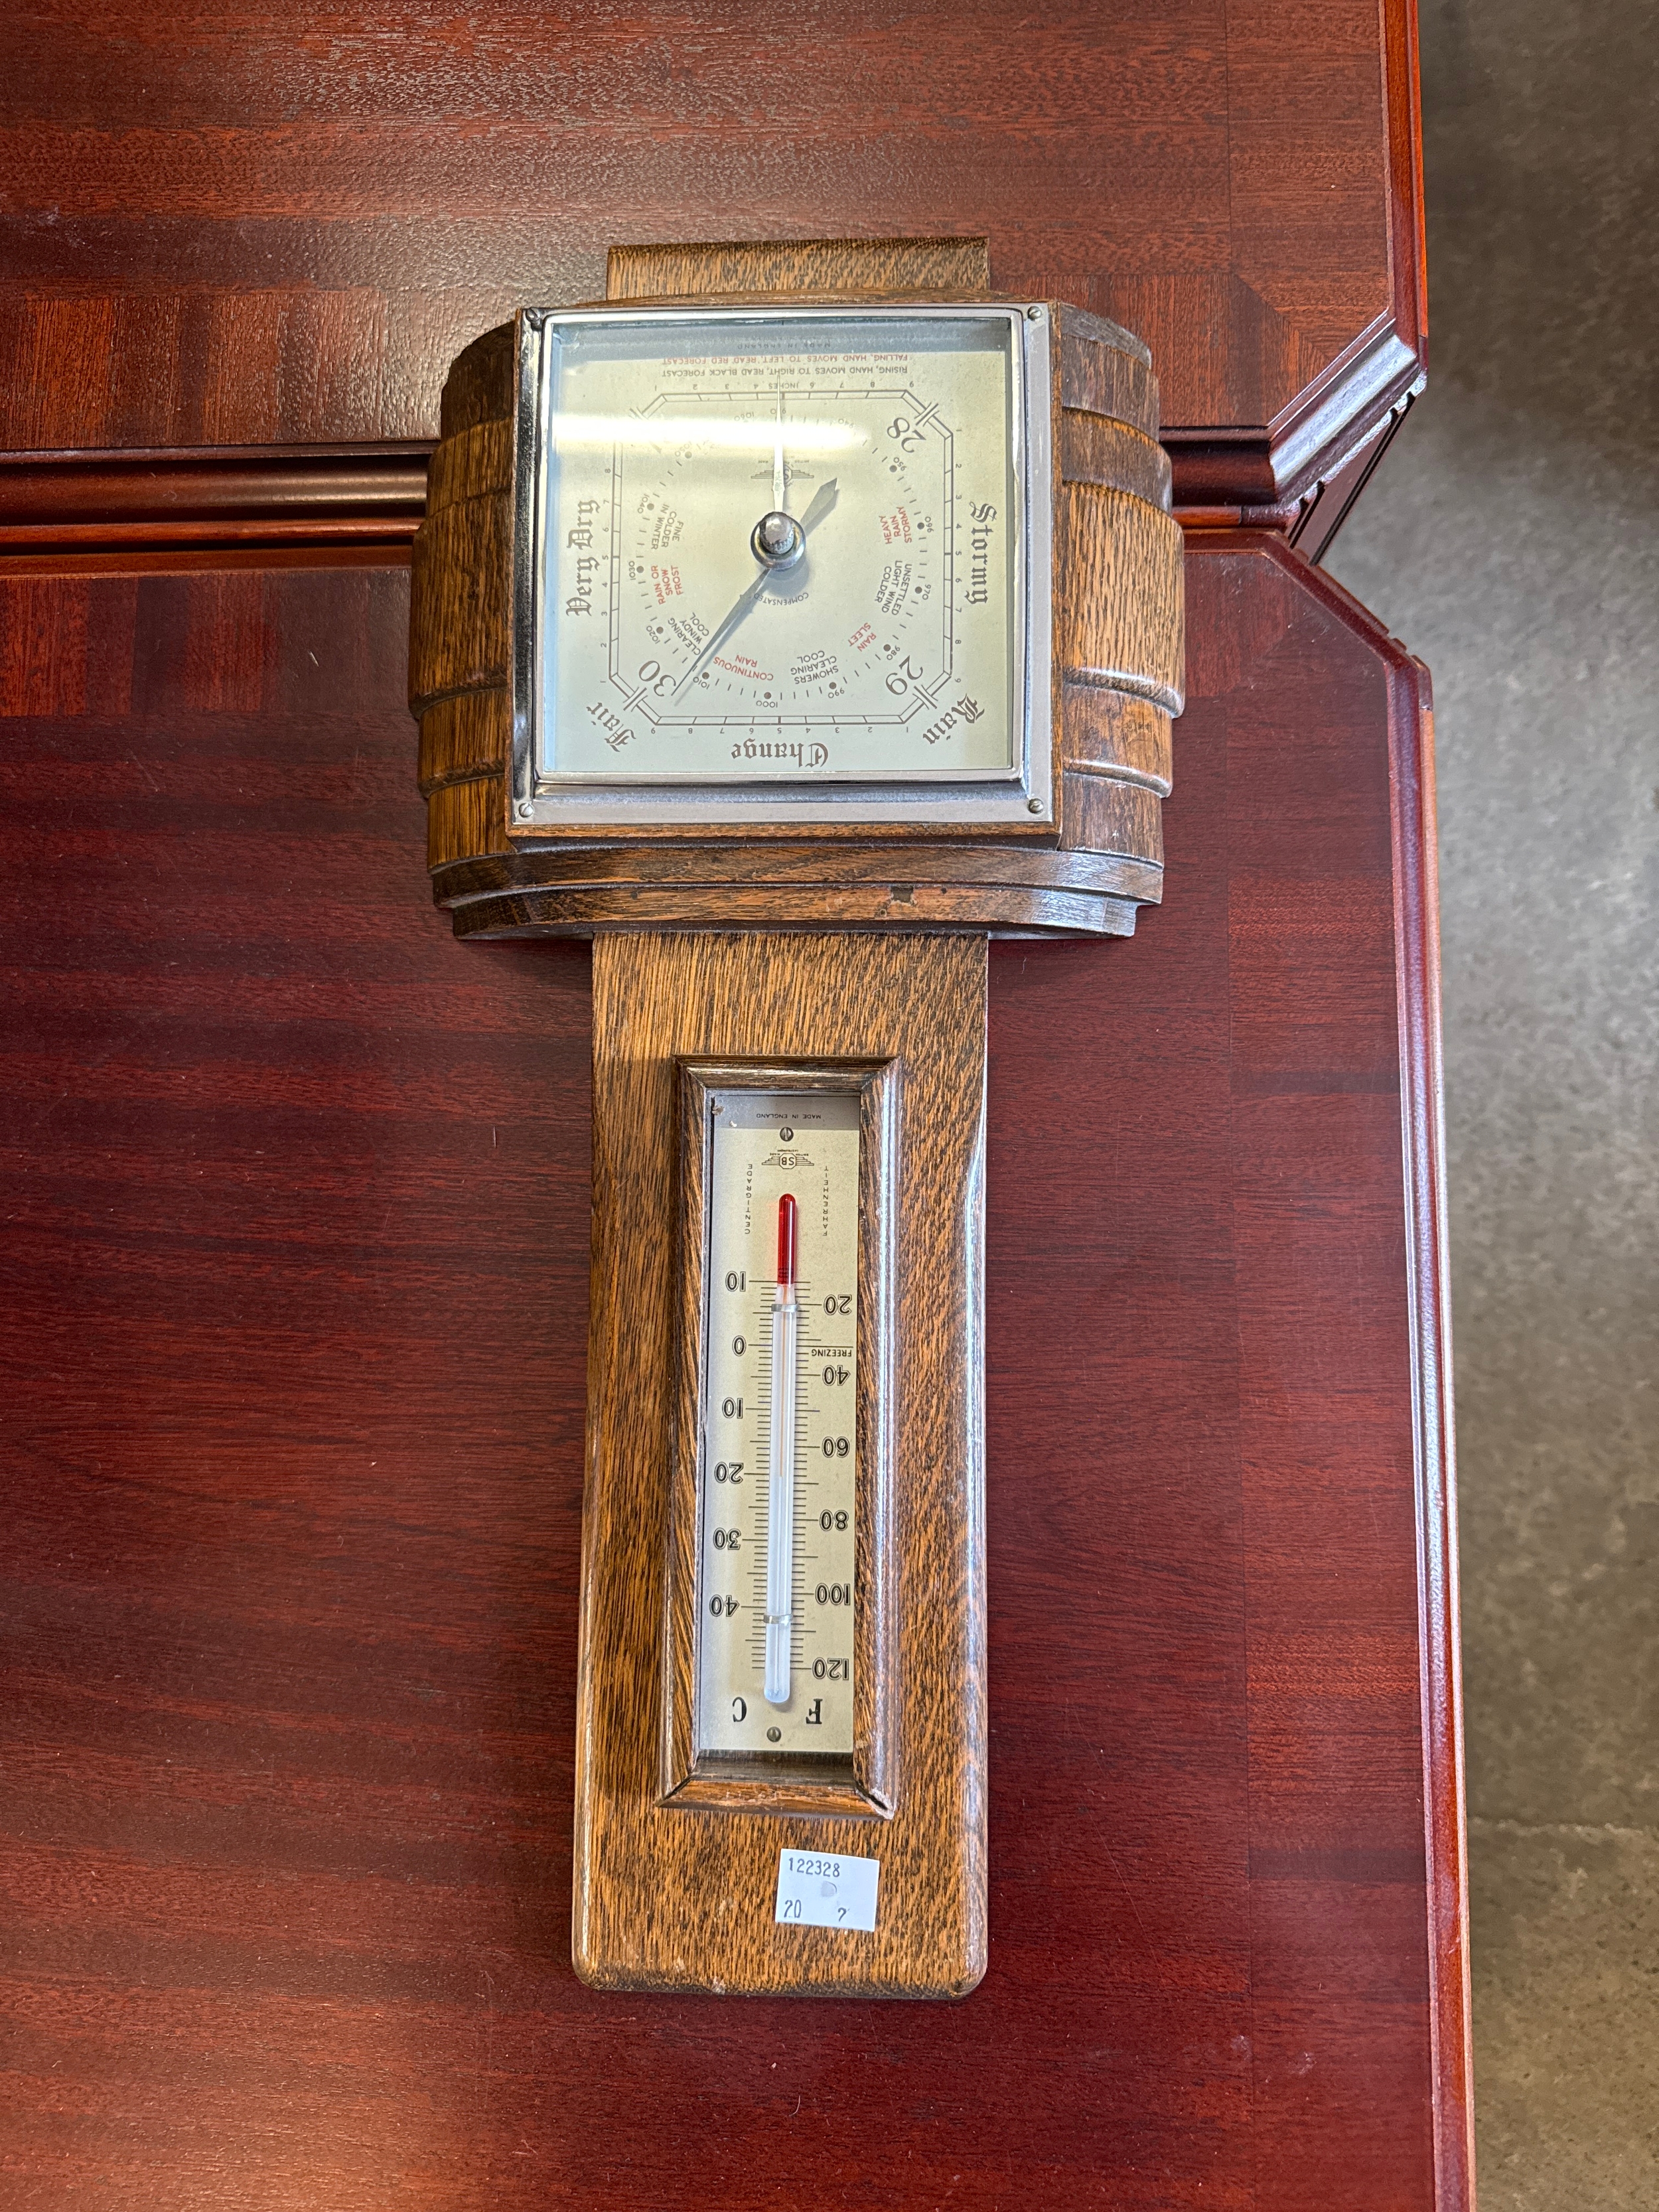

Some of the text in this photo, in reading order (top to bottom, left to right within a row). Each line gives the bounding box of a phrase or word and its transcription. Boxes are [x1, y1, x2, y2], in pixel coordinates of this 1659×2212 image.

[734, 411, 754, 421] 1060
[887, 417, 926, 453] 28
[893, 457, 907, 471] 950
[637, 494, 650, 514] 1040
[651, 504, 670, 550] IN WINTER
[661, 511, 677, 548] COLDER
[672, 521, 684, 542] FINE
[879, 515, 893, 545] HEAVY
[890, 515, 901, 537] RAIN
[897, 506, 912, 544] STORMY
[925, 516, 934, 533] 960
[565, 500, 600, 617] Very Dry
[964, 501, 997, 605] Stormy
[651, 565, 666, 605] RAIN OR
[661, 568, 673, 595] SNOW
[670, 565, 684, 595] FROST
[875, 565, 892, 603] COLDER
[881, 560, 902, 613] LIGHT WIND
[891, 563, 912, 616] UNSETTLED
[754, 592, 809, 606] COMPENSATED
[922, 584, 931, 600] 970
[646, 626, 660, 644] 1020
[680, 620, 702, 644] WINDY
[690, 612, 709, 636] COOL
[847, 622, 871, 646] SLEET
[668, 618, 701, 656] CLEARING
[857, 632, 877, 652] RAIN
[735, 654, 758, 668] RAIN
[797, 650, 825, 663] COOL
[886, 646, 901, 660] 980
[713, 656, 774, 681] CONTINUOUS
[790, 655, 837, 675] CLEARING
[794, 665, 839, 684] SHOWERS
[885, 655, 924, 696] 29
[638, 660, 676, 697] 30
[692, 676, 710, 690] 1010
[828, 688, 845, 699] 990
[586, 702, 636, 753] Fair
[922, 694, 985, 745] Rain
[731, 738, 828, 768] Change
[782, 1157, 794, 1165] SB
[745, 1163, 753, 1234] CENTIGRADE
[725, 1271, 747, 1292] 10
[823, 1294, 852, 1316] 20
[731, 1335, 747, 1357] 0
[822, 1365, 851, 1386] 40
[722, 1397, 744, 1419] 10
[821, 1436, 850, 1458] 60
[714, 1461, 744, 1485] 20
[819, 1509, 849, 1532] 80
[713, 1528, 742, 1550] 30
[709, 1594, 740, 1617] 40
[815, 1583, 851, 1606] 100
[812, 1657, 849, 1680] 120
[732, 1697, 747, 1722] C
[806, 1698, 823, 1725] F
[789, 1857, 840, 1878] 122328
